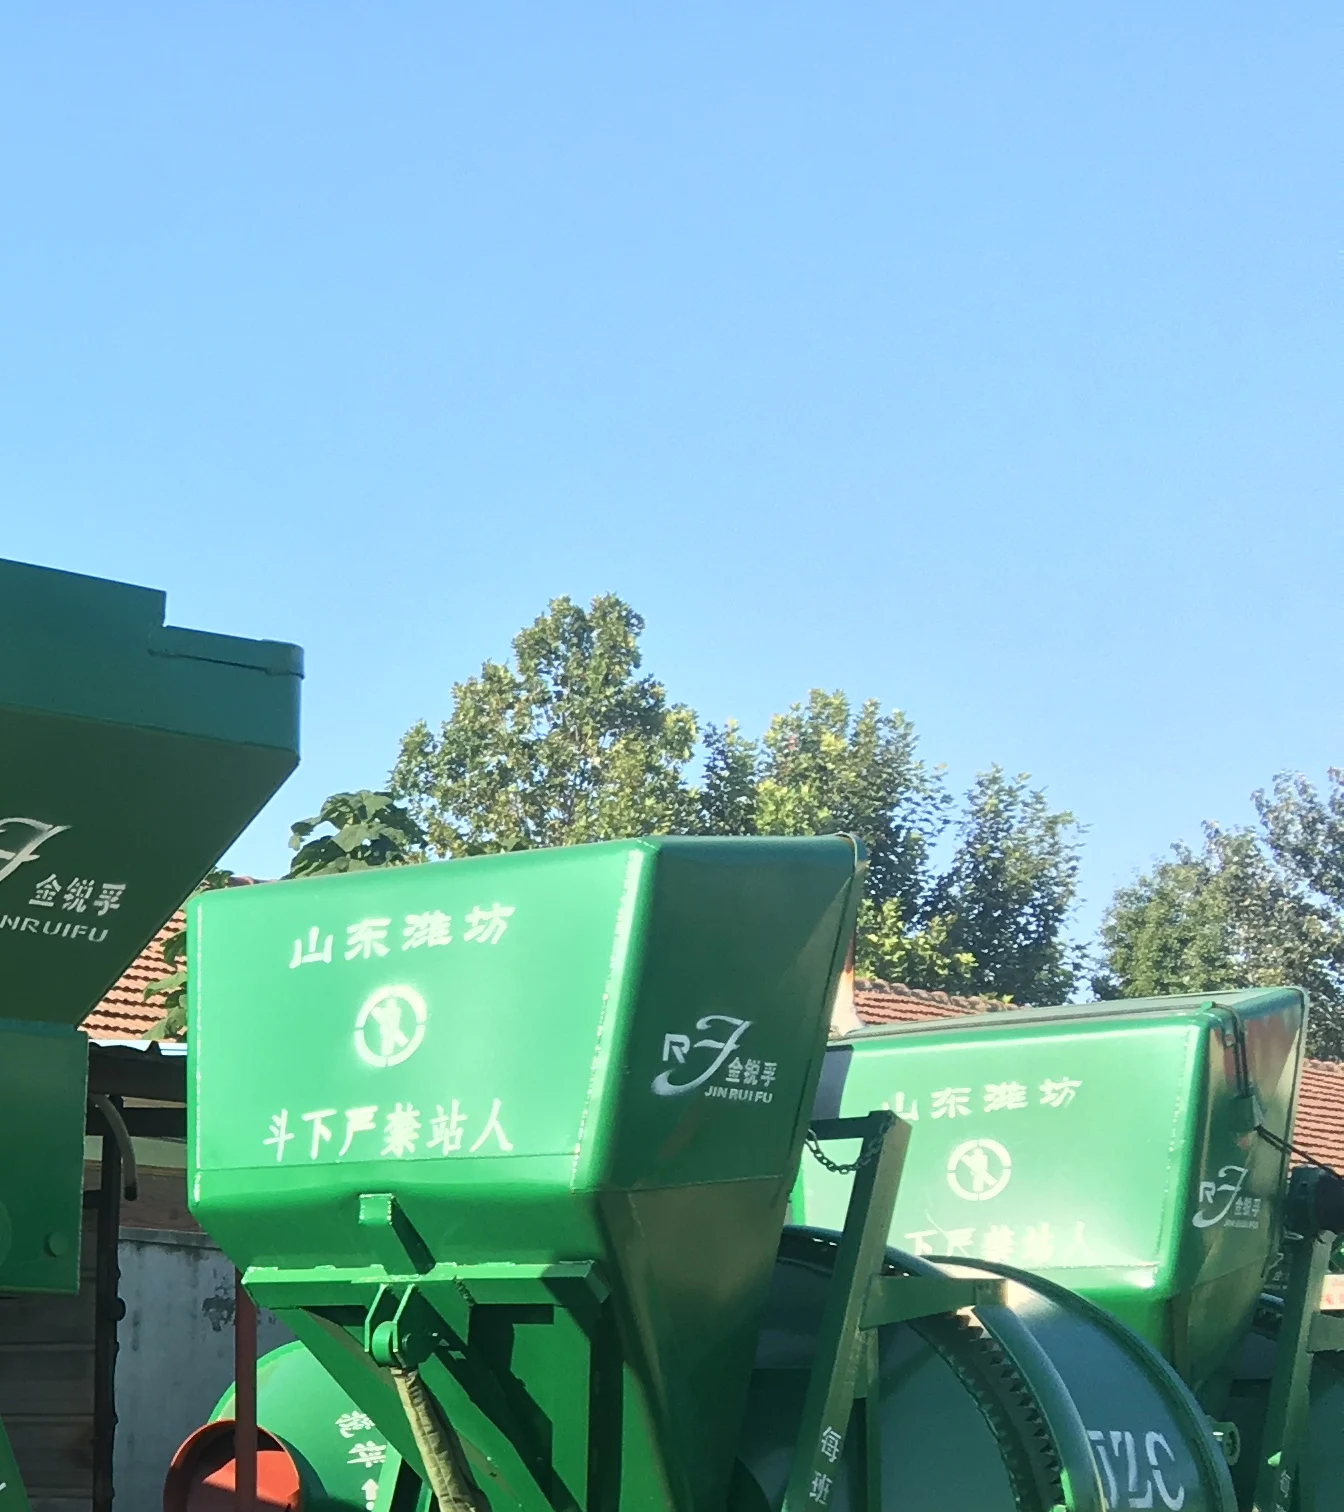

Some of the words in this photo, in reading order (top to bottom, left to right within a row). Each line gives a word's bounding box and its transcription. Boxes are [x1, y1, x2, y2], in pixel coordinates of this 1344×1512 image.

[288, 902, 516, 969] 山东潍坊
[262, 1097, 514, 1163] 斗下严禁站人
[881, 1076, 1083, 1121] 山东潍坊
[1086, 1430, 1185, 1512] JZC
